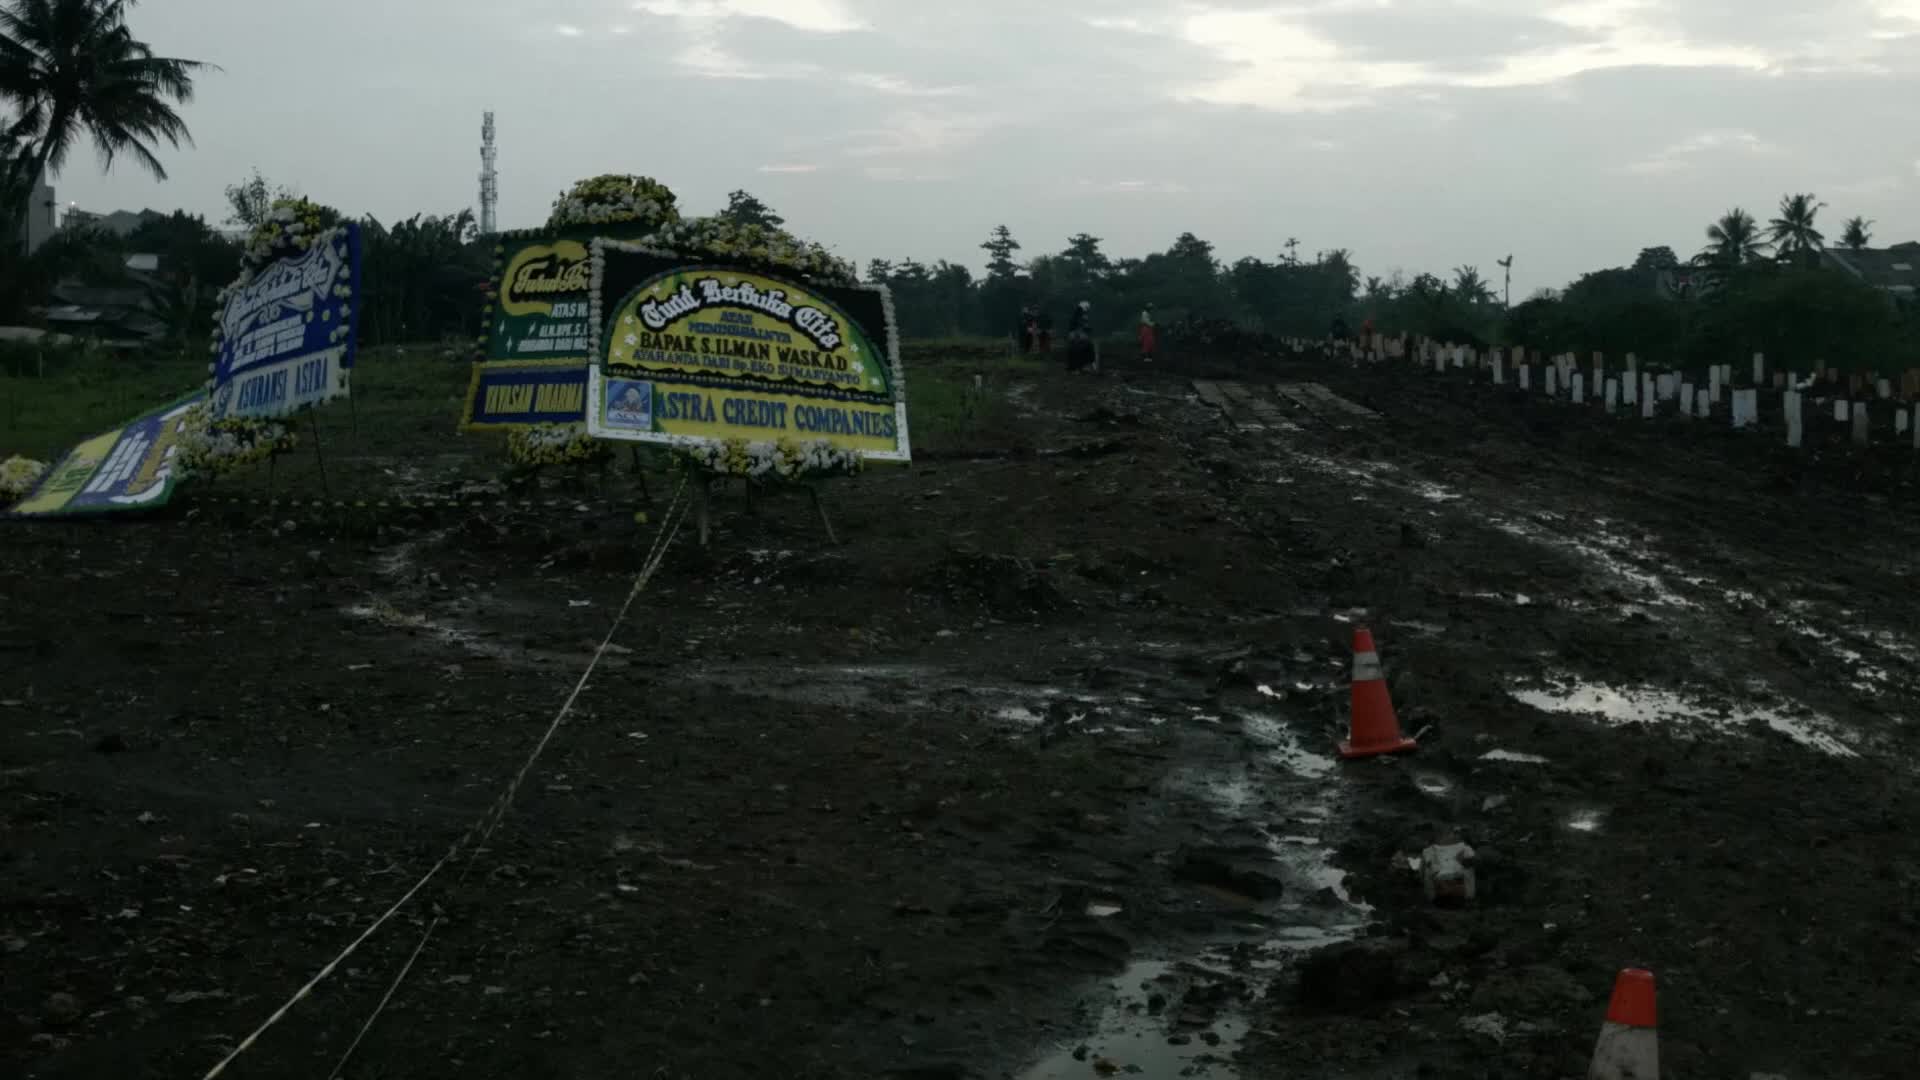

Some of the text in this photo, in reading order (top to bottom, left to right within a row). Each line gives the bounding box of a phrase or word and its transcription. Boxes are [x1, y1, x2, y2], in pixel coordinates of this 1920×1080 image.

[550, 302, 577, 319] ATAS
[699, 279, 793, 318] Berduka
[640, 332, 697, 353] BAPAK
[776, 346, 848, 371] WASKAD
[703, 354, 730, 367] DARI
[295, 357, 328, 396] ASTRA
[656, 391, 896, 438] ASTRA CREDIT COMPANIES
